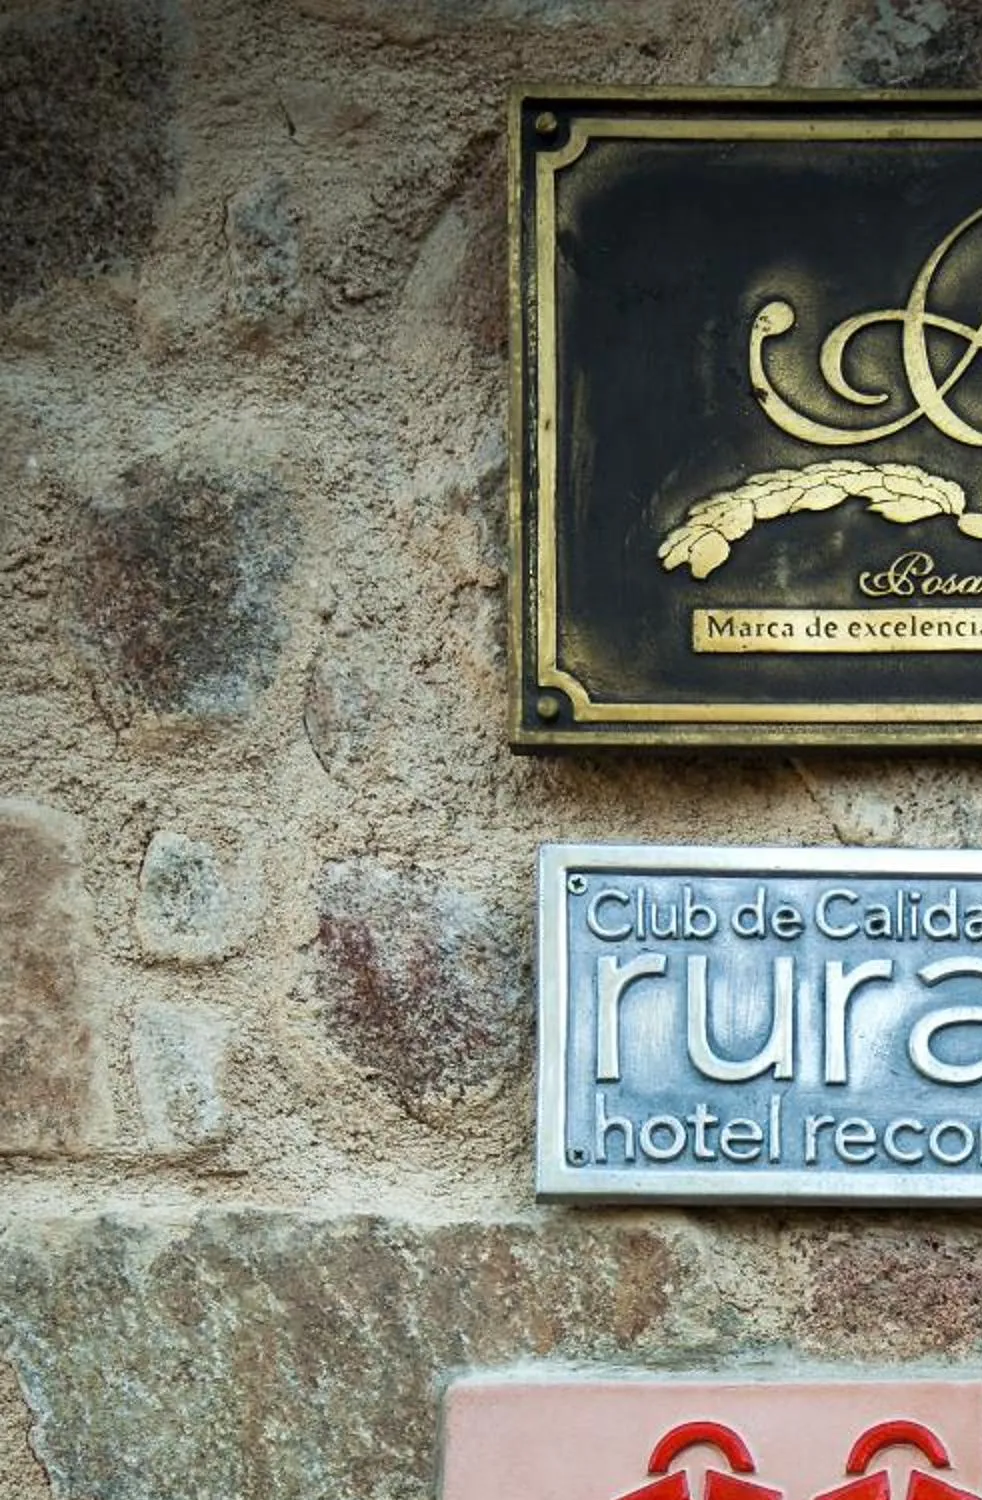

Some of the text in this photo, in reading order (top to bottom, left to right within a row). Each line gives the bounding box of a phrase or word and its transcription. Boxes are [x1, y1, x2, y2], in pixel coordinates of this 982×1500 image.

[706, 615, 795, 639] Marca
[805, 613, 838, 638] de
[586, 888, 718, 940] Club
[730, 888, 803, 940] de
[595, 1091, 783, 1166] hotel
